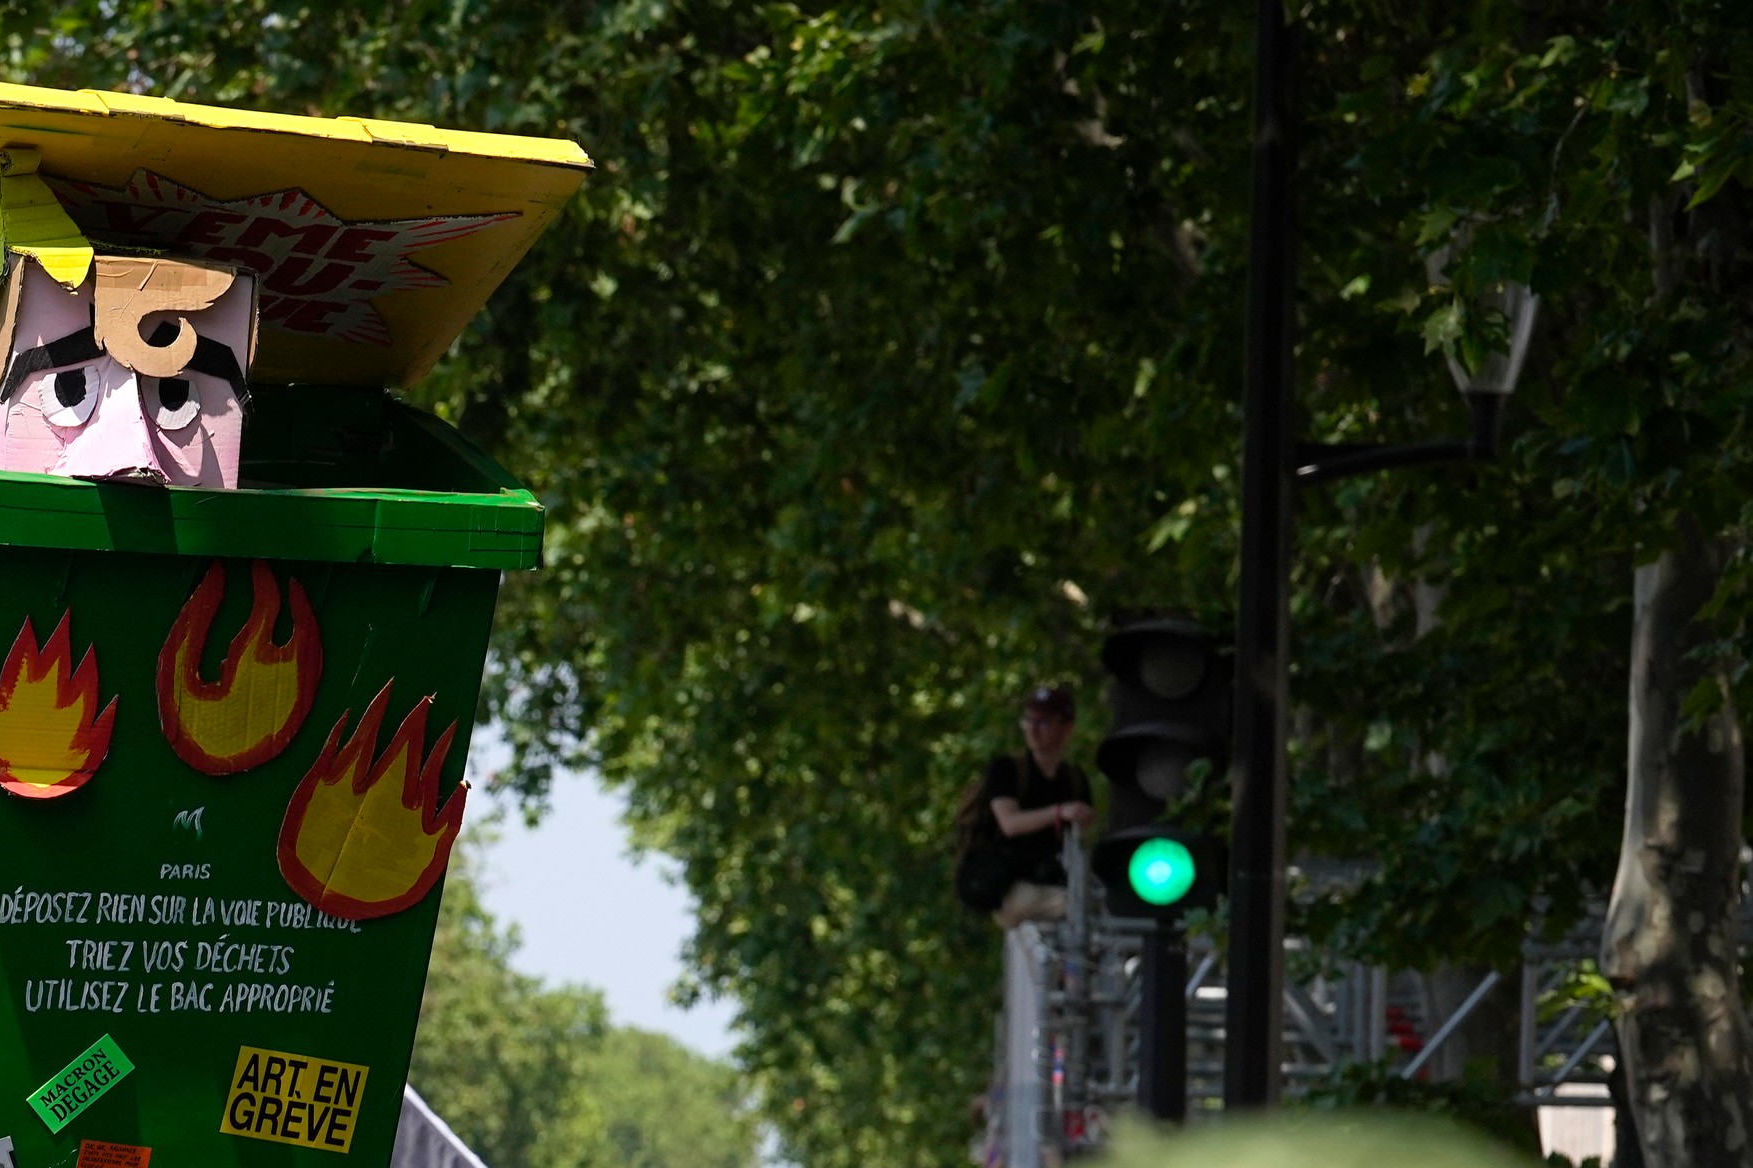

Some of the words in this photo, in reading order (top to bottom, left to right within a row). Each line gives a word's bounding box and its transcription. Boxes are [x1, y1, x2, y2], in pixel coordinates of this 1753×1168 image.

[160, 863, 211, 879] PARIS
[96, 892, 145, 924] RIEN
[148, 895, 186, 925] SUR
[191, 896, 216, 926] LA
[220, 898, 262, 926] VOIE
[65, 939, 134, 971] TRIEZ
[142, 940, 189, 973] VOS
[195, 933, 295, 975] DÉCHETS
[25, 978, 129, 1012] UTILISEZ
[137, 982, 163, 1013] LE
[170, 980, 214, 1012] BAC
[219, 979, 335, 1013] APPROPRIÉ
[39, 1048, 107, 1107] MACRON
[49, 1060, 120, 1123] DEGAGE
[237, 1053, 308, 1098] ART
[313, 1064, 361, 1108] EN
[229, 1090, 352, 1147] GRÈVE
